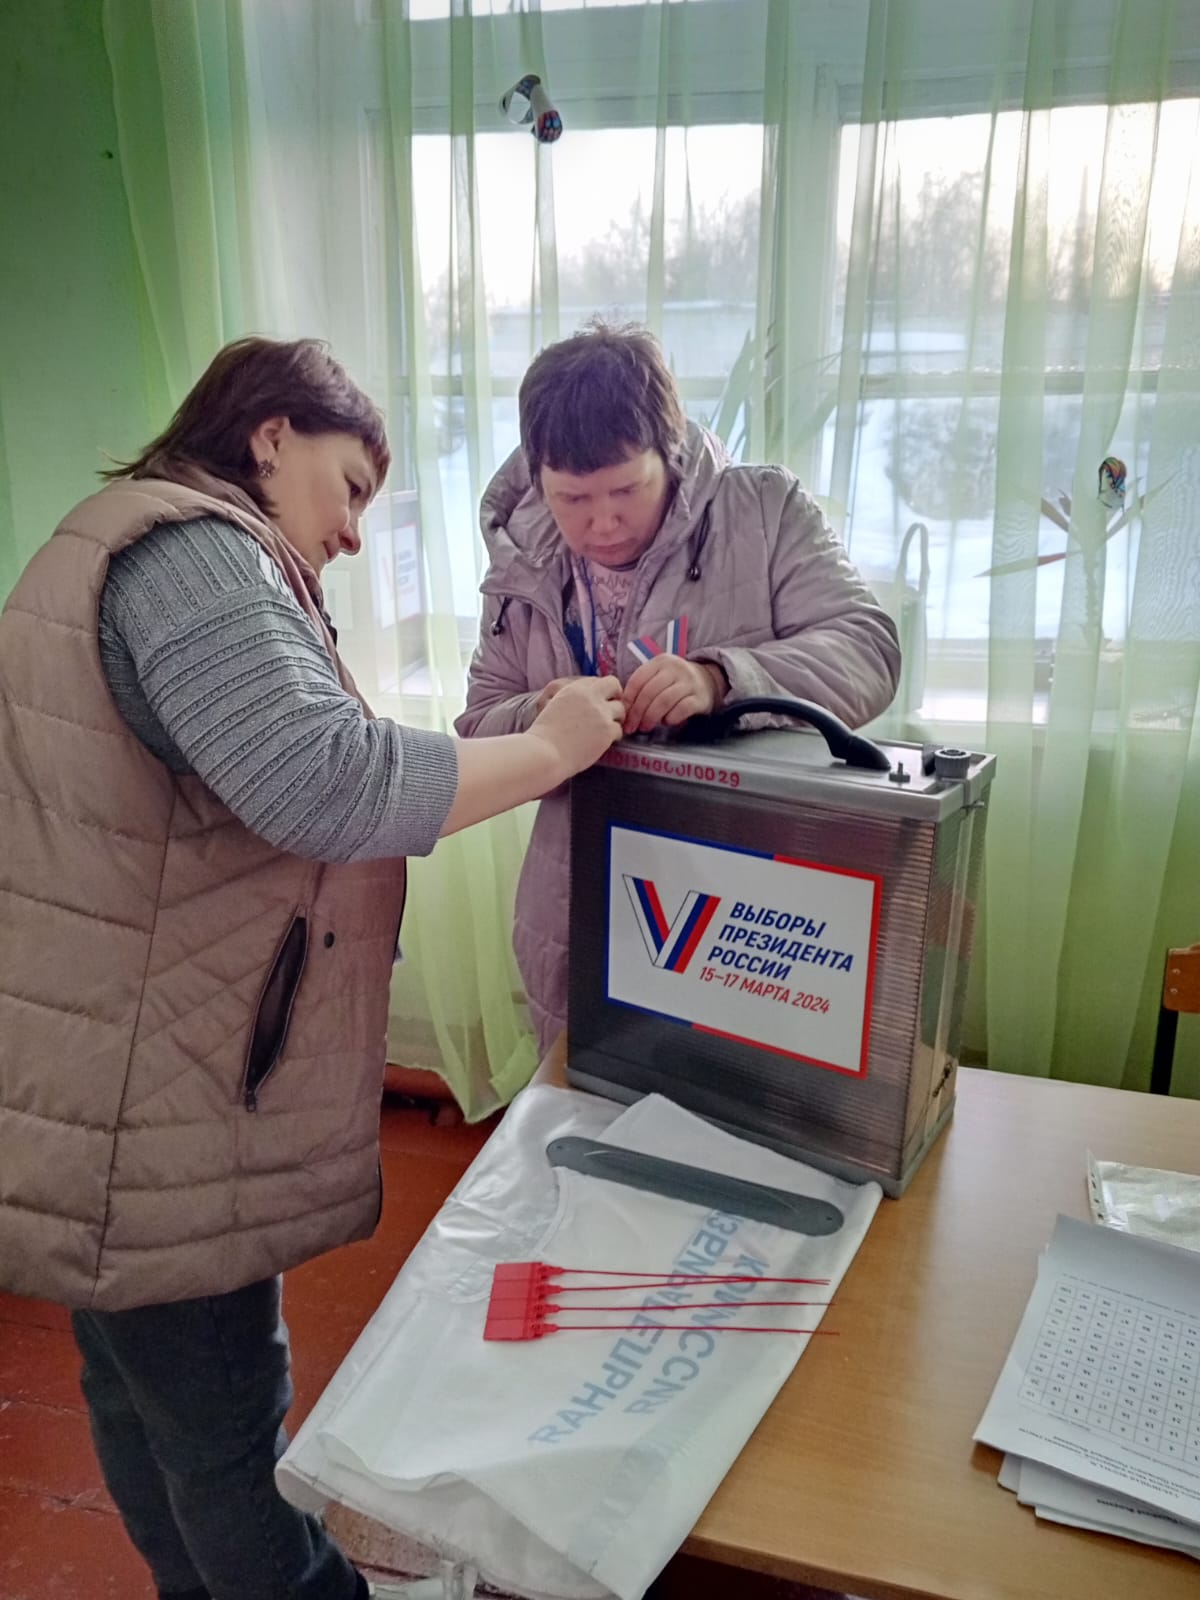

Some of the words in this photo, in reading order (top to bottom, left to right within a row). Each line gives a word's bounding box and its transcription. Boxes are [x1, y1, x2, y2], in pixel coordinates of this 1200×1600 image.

[730, 902, 827, 939] ВЫБОРЫ
[707, 946, 793, 981] РОССИИ
[718, 924, 854, 972] ПРЕЗИДЕНТА
[739, 977, 790, 1004] МАРТА
[792, 991, 831, 1015] 2024
